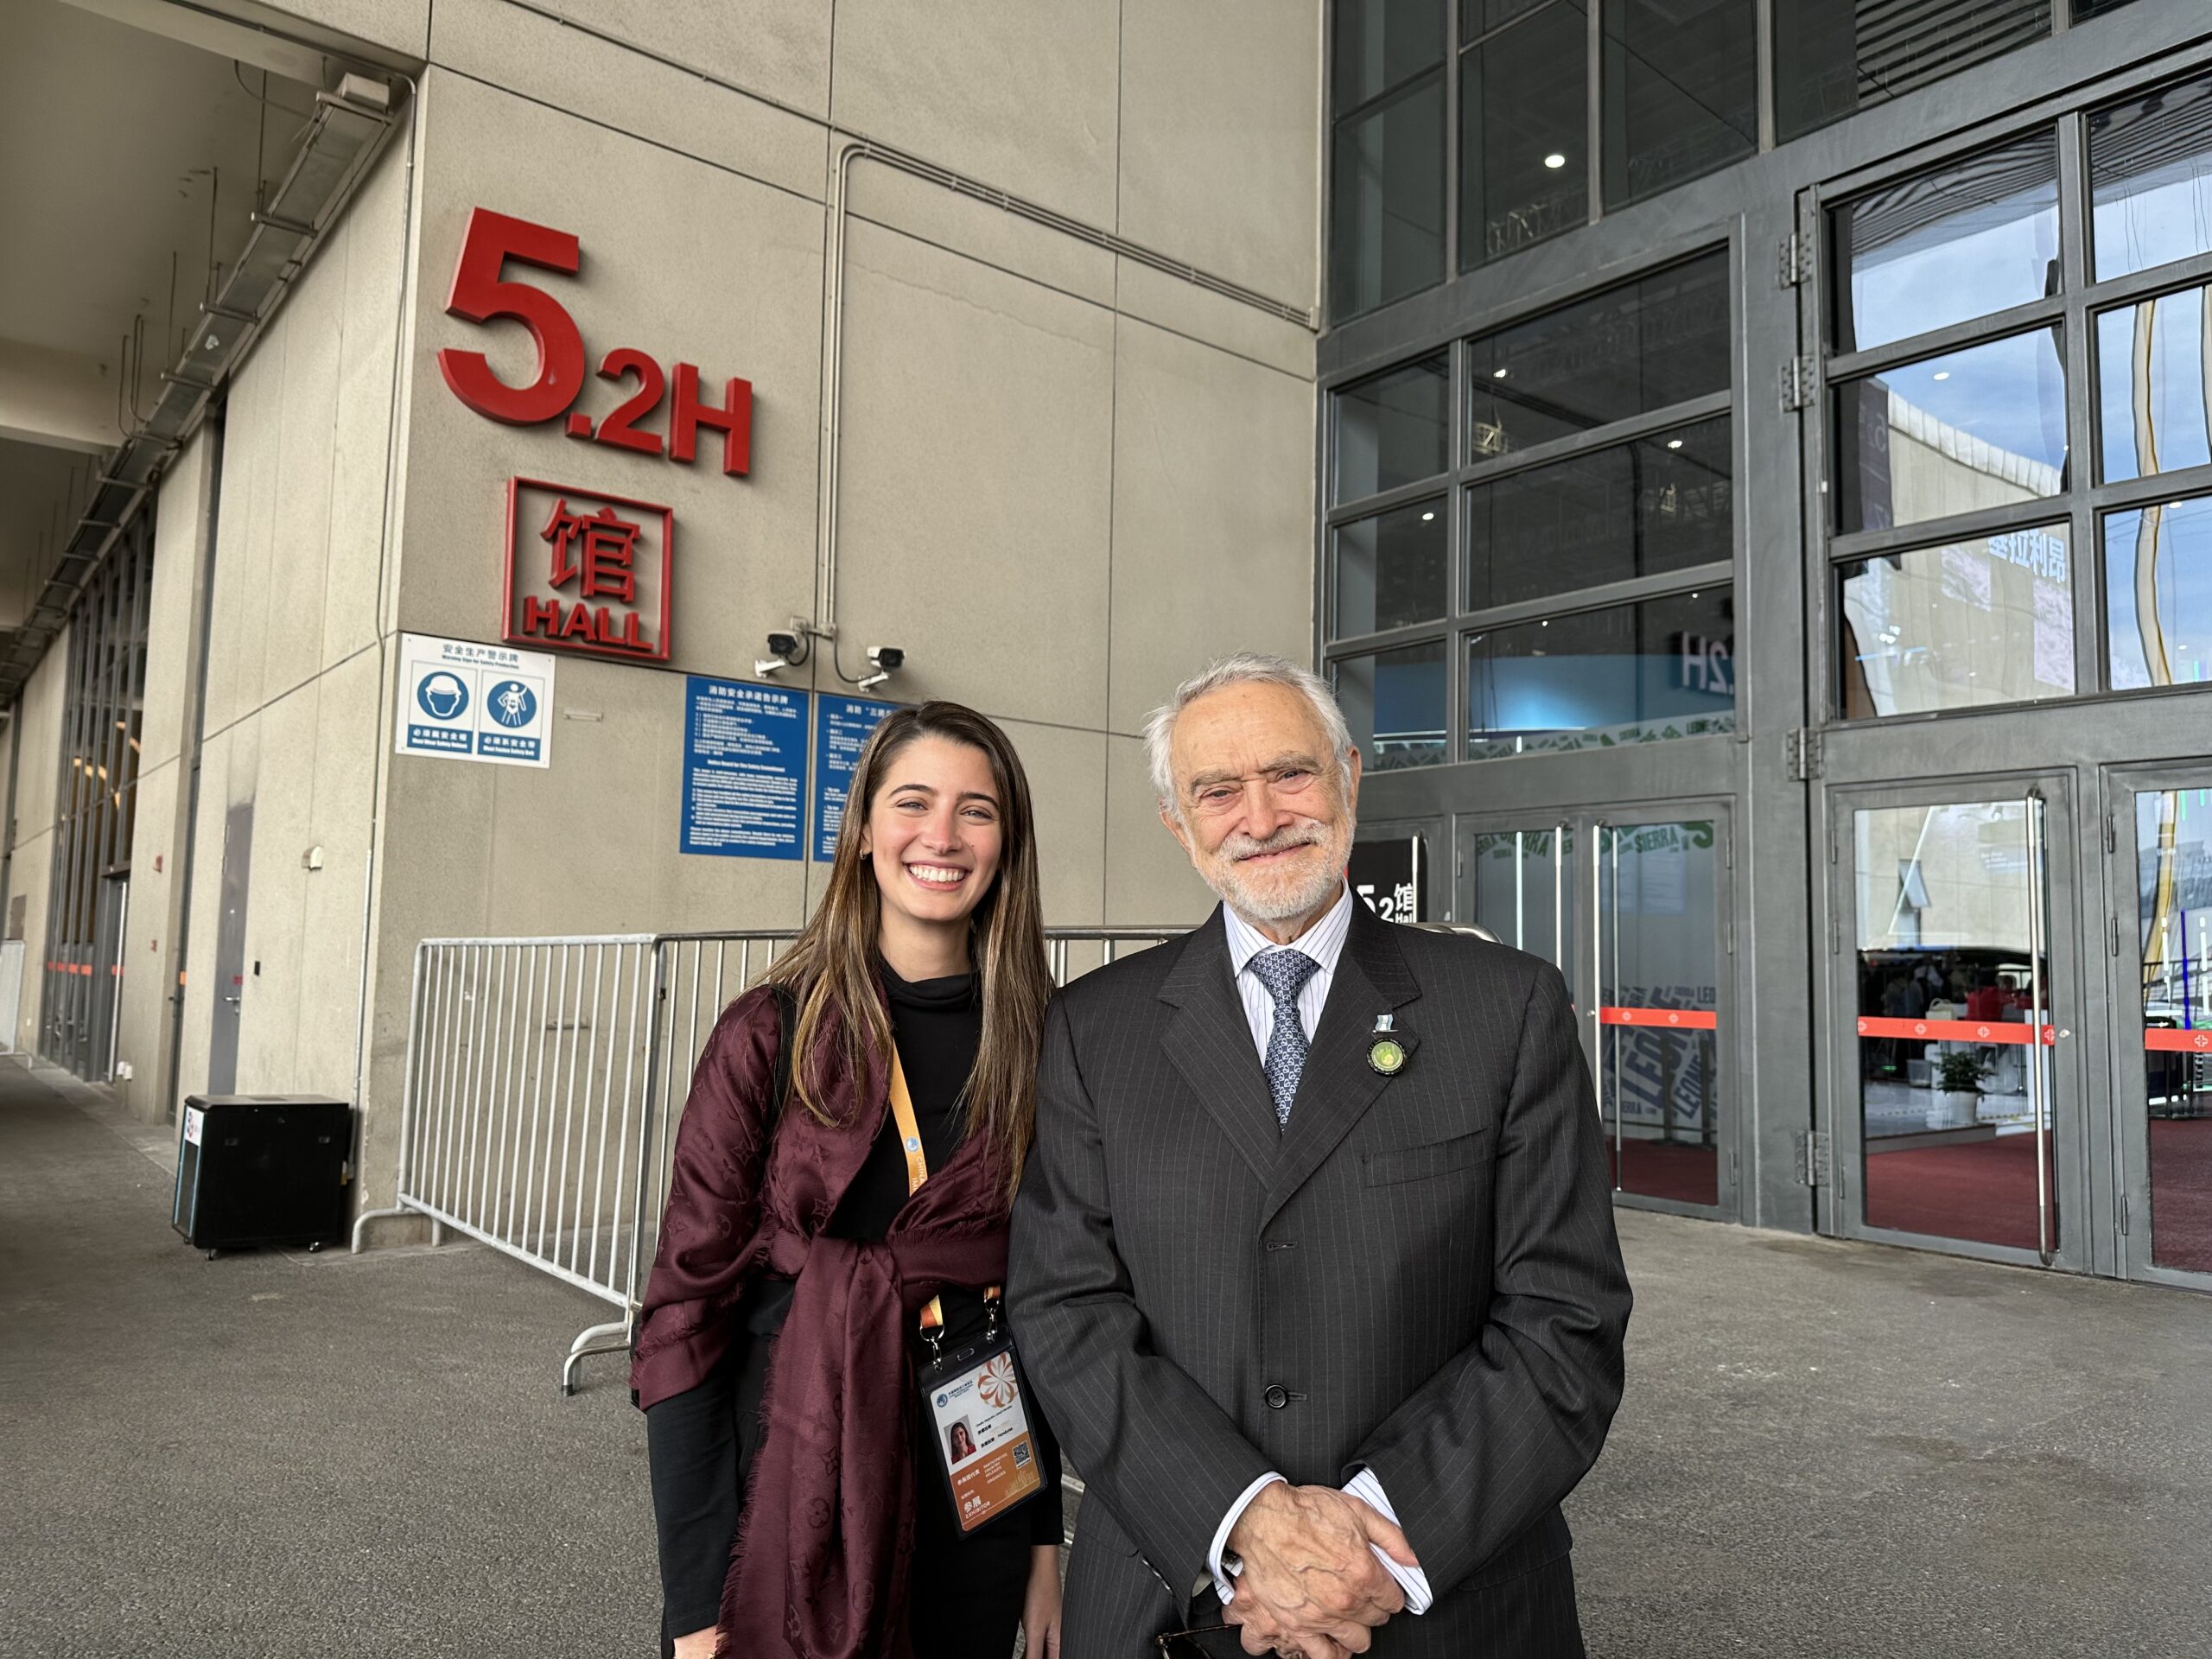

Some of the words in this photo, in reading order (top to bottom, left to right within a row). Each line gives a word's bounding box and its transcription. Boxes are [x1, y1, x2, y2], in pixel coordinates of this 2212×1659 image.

[436, 207, 753, 476] 5.2H
[540, 499, 641, 602] 馆
[524, 595, 654, 652] HALL
[443, 644, 518, 662] 安全生产警示牌
[1635, 826, 1680, 853] SIERRA
[1395, 912, 1417, 924] Hal
[965, 1501, 991, 1519] EXHIBITOR
